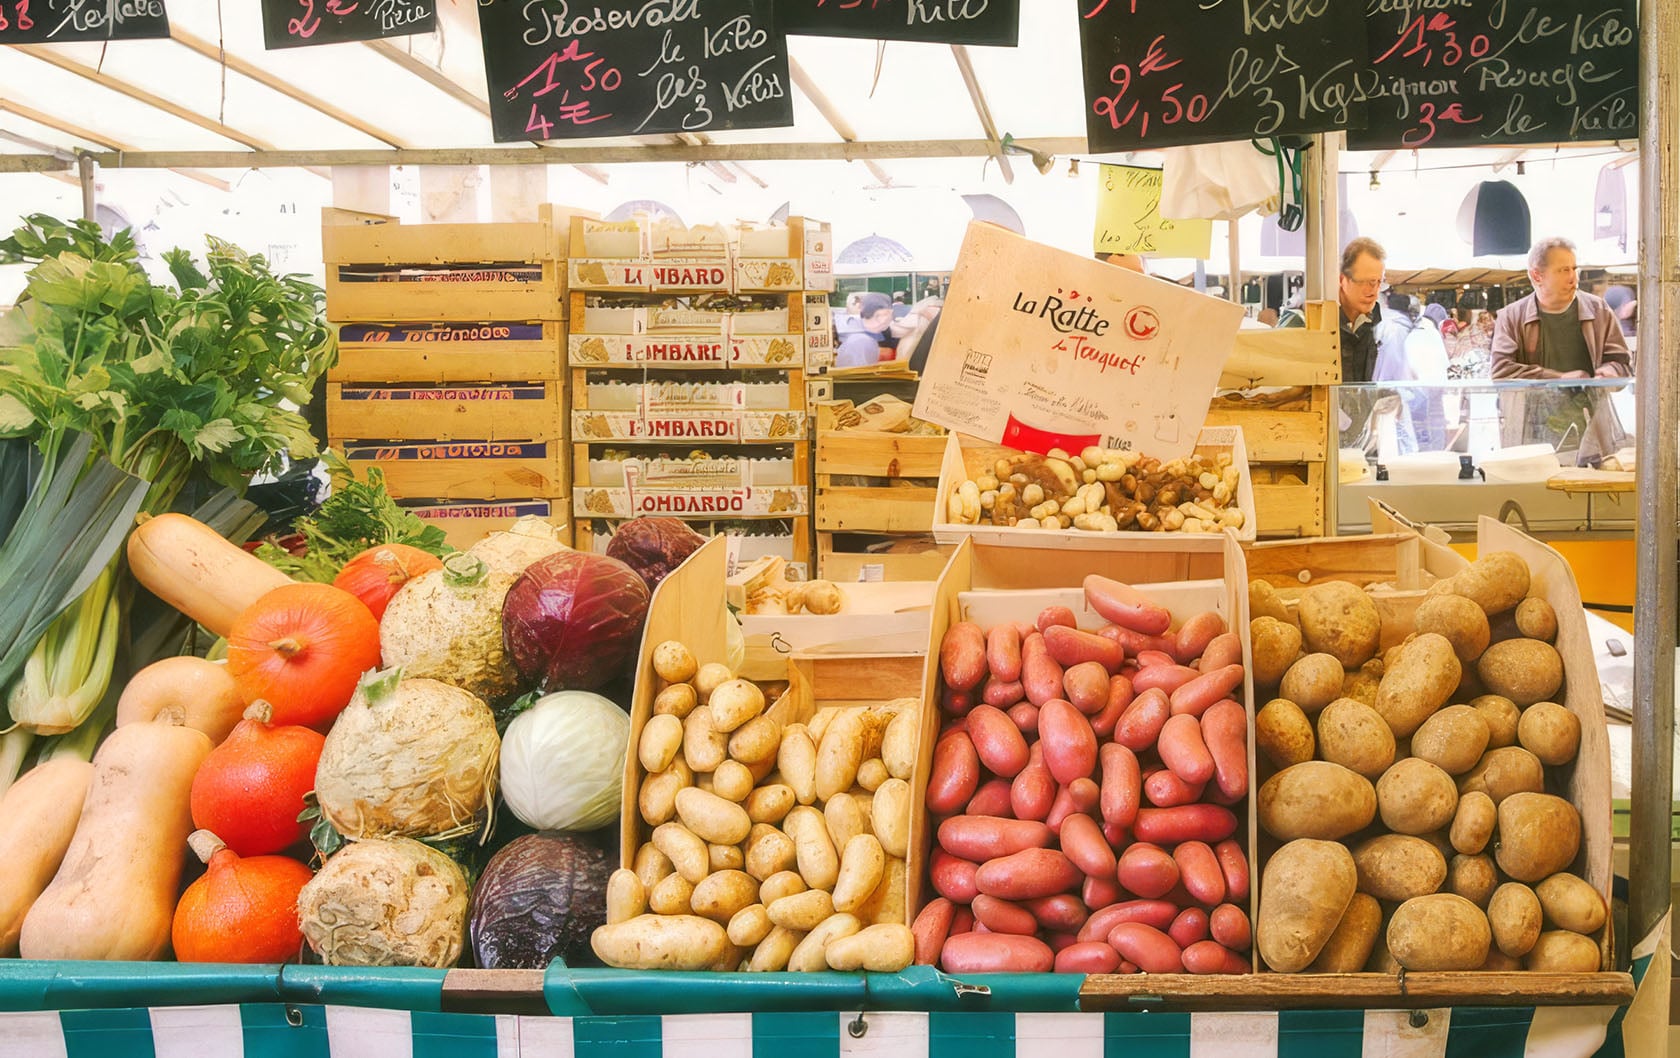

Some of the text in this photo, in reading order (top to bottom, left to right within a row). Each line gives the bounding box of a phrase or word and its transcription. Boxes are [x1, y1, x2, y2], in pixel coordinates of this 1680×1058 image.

[638, 29, 685, 76] le
[704, 15, 768, 58] Kilo
[1570, 9, 1633, 54] Kilo
[633, 65, 707, 133] les
[682, 93, 713, 130] 3
[721, 55, 784, 112] Kilos
[1202, 44, 1300, 121] les
[1464, 58, 1624, 106] Rouge
[1253, 87, 1286, 135] 3
[1481, 93, 1547, 139] le
[1569, 86, 1640, 142] Kilo
[1013, 292, 1109, 337] La Ratte
